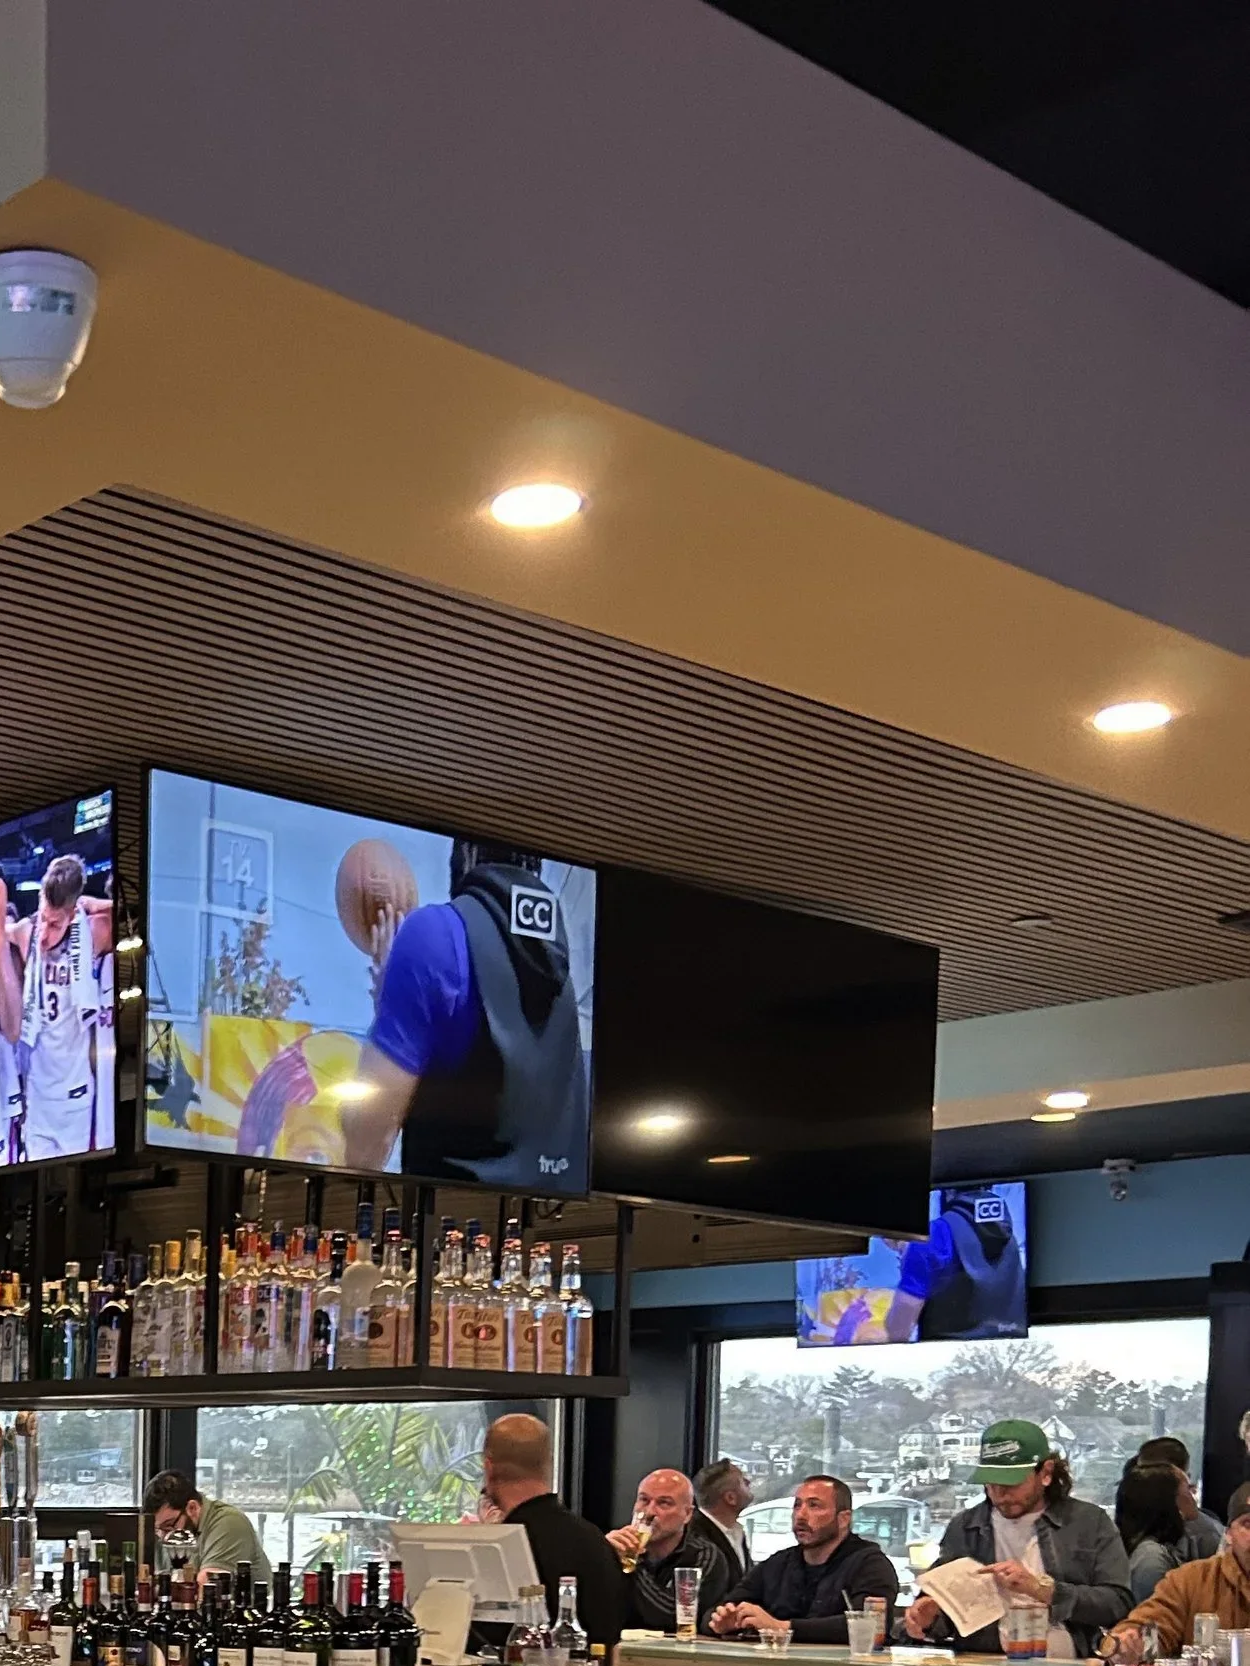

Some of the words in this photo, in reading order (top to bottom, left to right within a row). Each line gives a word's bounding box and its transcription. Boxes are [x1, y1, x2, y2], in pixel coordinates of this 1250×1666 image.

[220, 855, 254, 887] 14
[518, 898, 550, 928] CC
[979, 1203, 1000, 1217] CC
